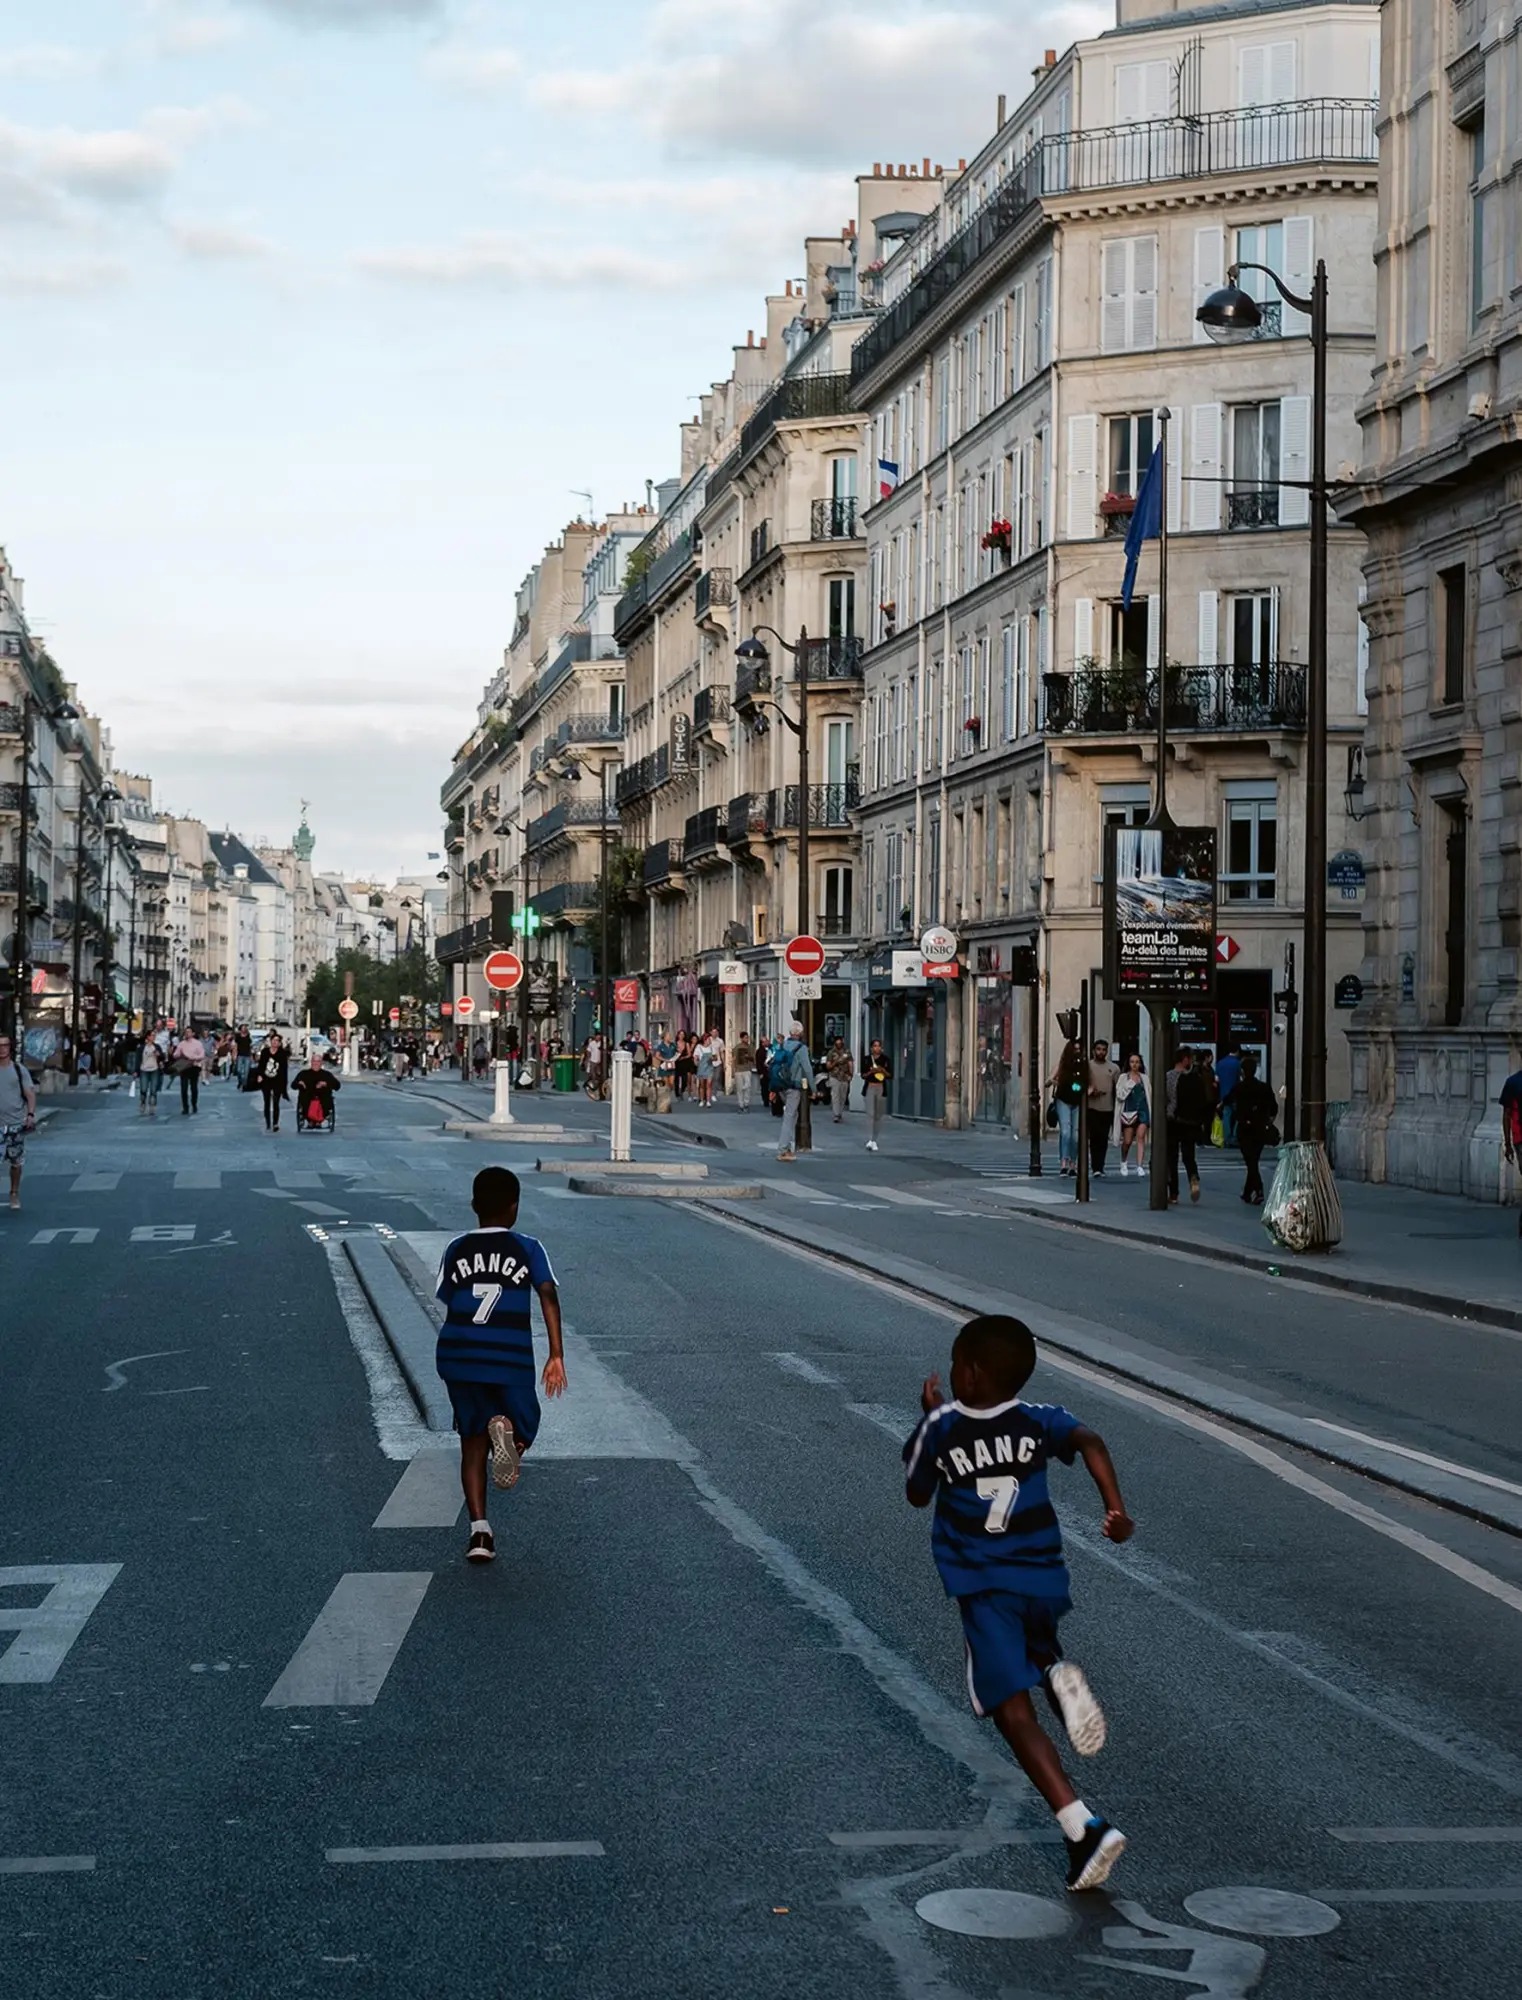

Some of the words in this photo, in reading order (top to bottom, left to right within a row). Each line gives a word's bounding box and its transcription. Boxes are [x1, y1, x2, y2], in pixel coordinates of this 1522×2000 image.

[1343, 888, 1355, 898] 30
[1122, 920, 1165, 930] L'exposition
[1121, 930, 1179, 945] teamLab
[925, 945, 954, 955] HSBC
[1121, 944, 1158, 955] Au-delà
[1159, 945, 1177, 955] des
[1178, 945, 1208, 956] limites
[472, 1283, 503, 1325] 7
[976, 1475, 1020, 1534] 7
